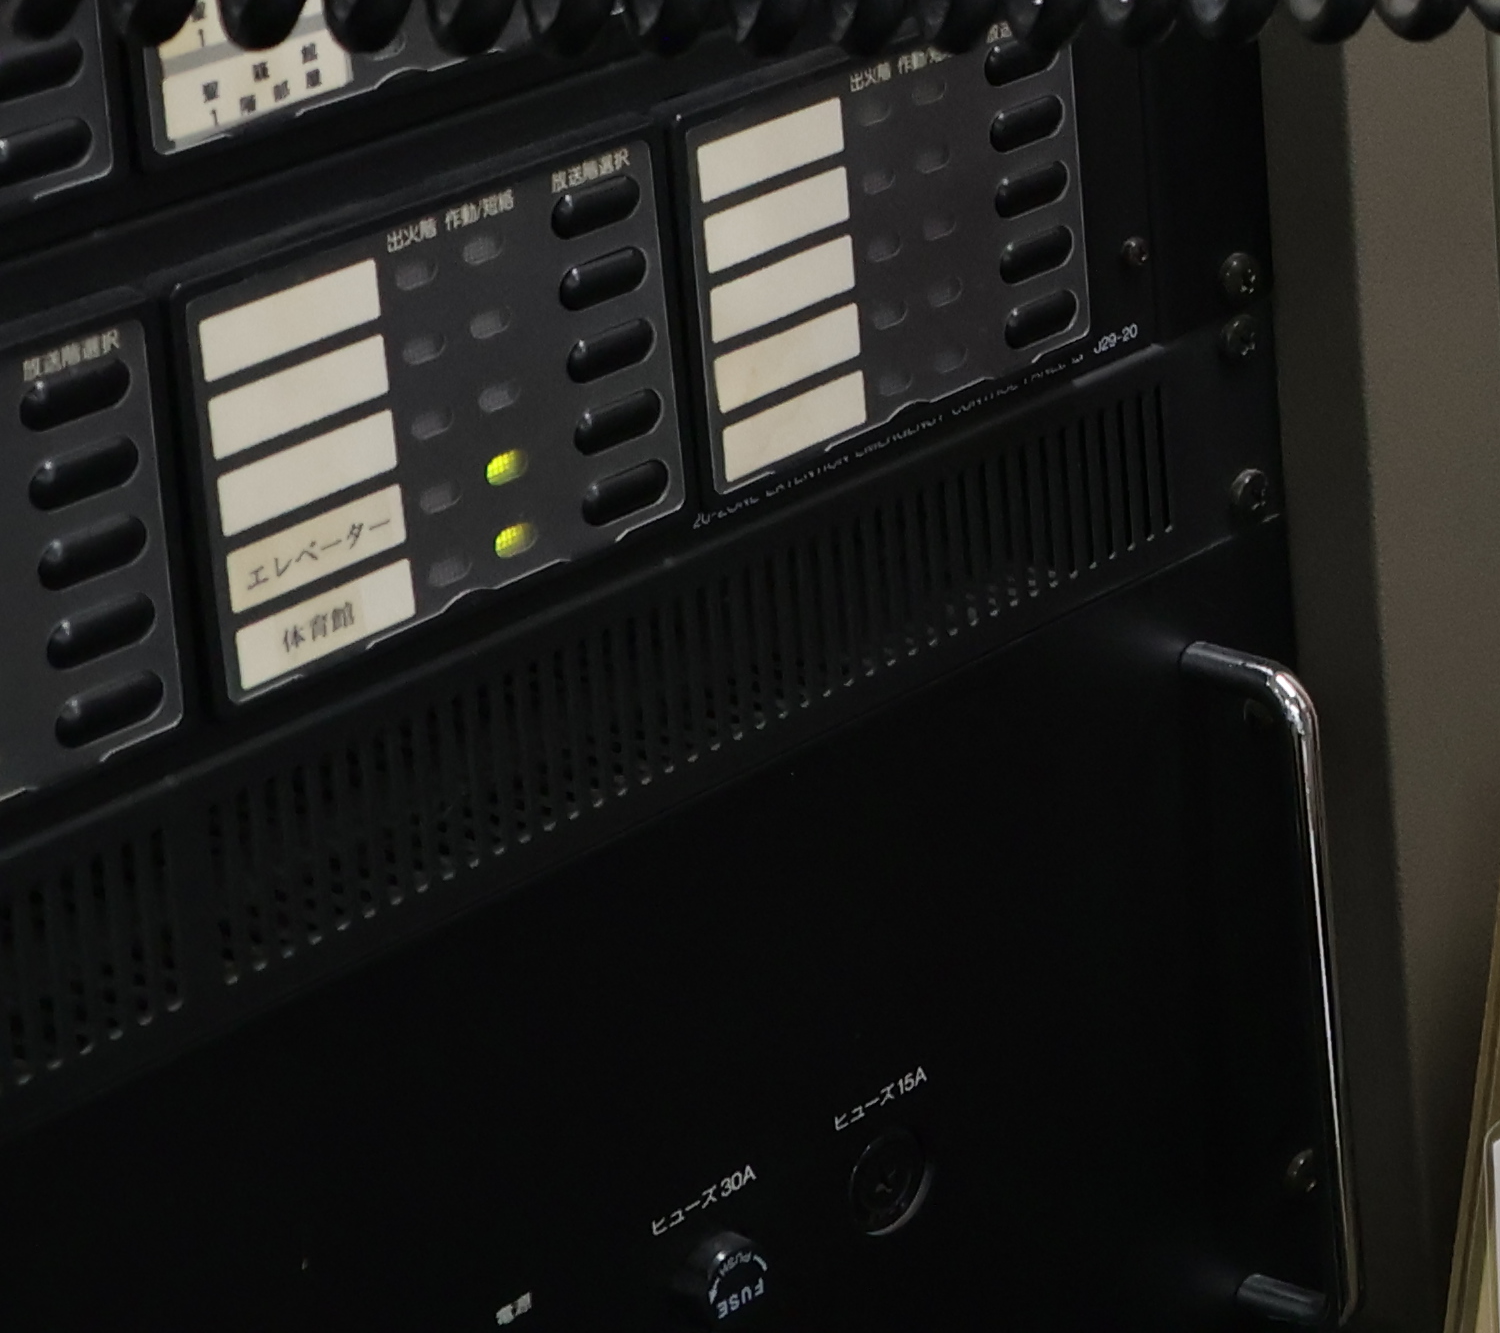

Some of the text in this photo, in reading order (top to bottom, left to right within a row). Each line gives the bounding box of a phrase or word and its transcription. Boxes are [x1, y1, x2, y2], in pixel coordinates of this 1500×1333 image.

[386, 217, 437, 253] 出火階
[248, 519, 390, 590] エレベーター
[283, 601, 356, 653] 体育館
[716, 1277, 765, 1319] FUSE
